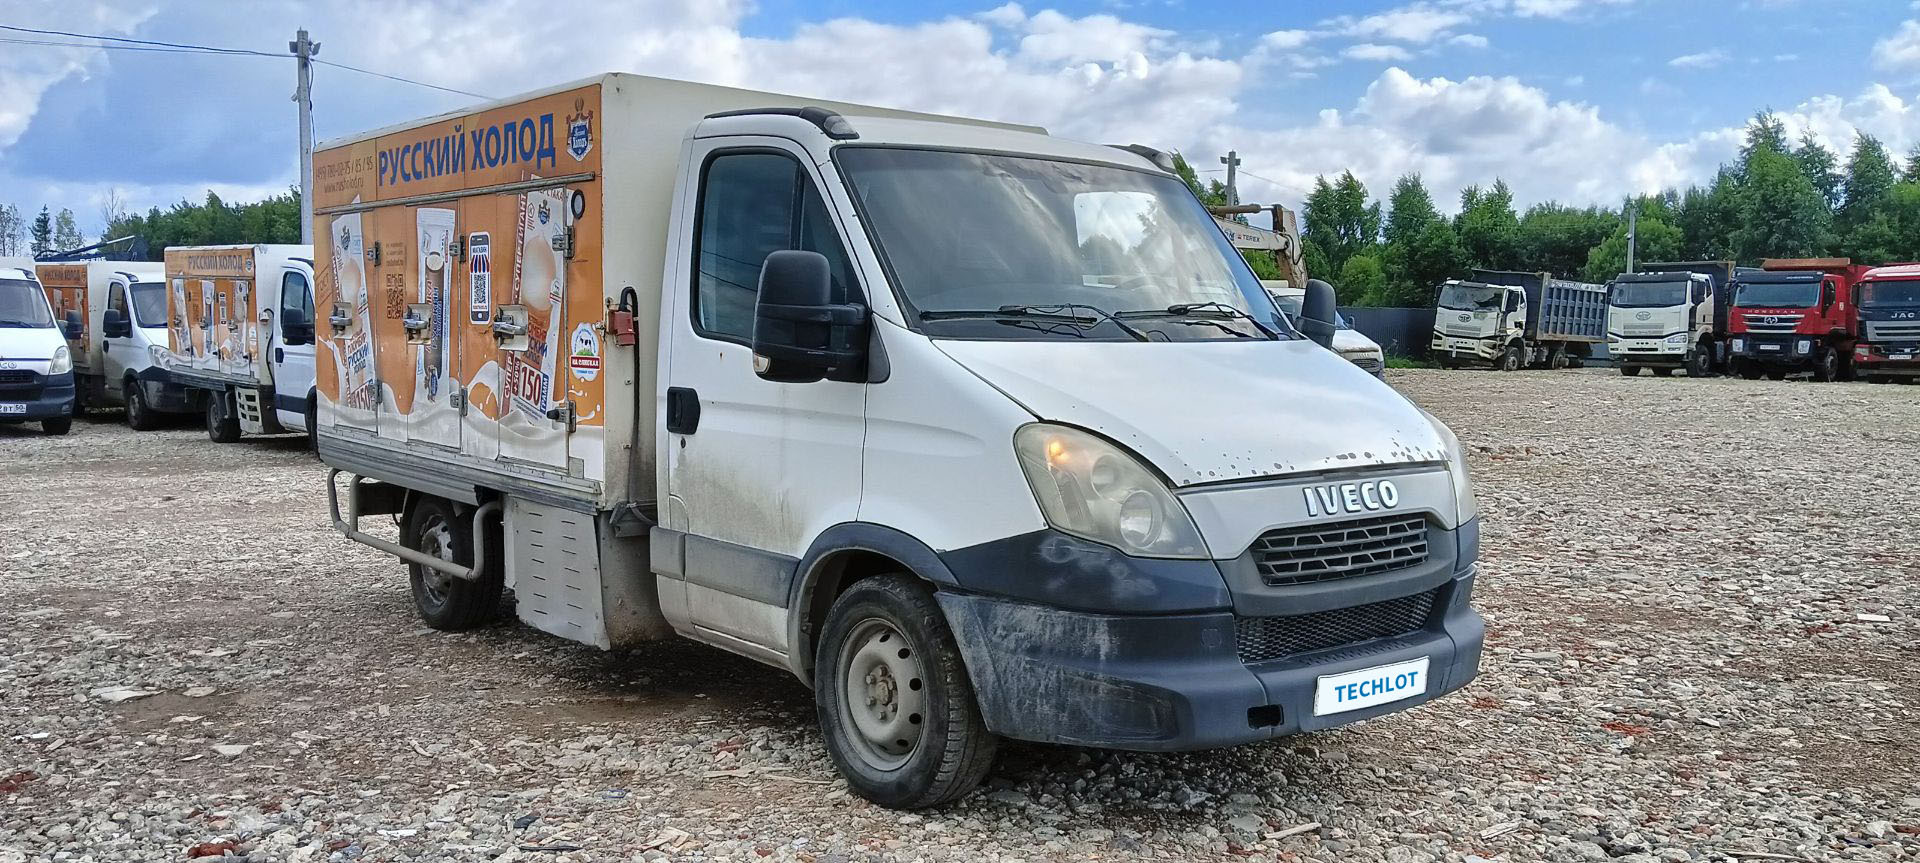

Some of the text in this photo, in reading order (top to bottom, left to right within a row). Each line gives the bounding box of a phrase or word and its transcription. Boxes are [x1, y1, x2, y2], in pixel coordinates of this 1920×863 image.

[378, 112, 556, 187] РУССКИЙ ХОЛОД
[1243, 234, 1260, 242] TEREX
[521, 366, 541, 406] 150
[540, 377, 549, 413] ГРАММ
[1302, 478, 1399, 517] IVECO
